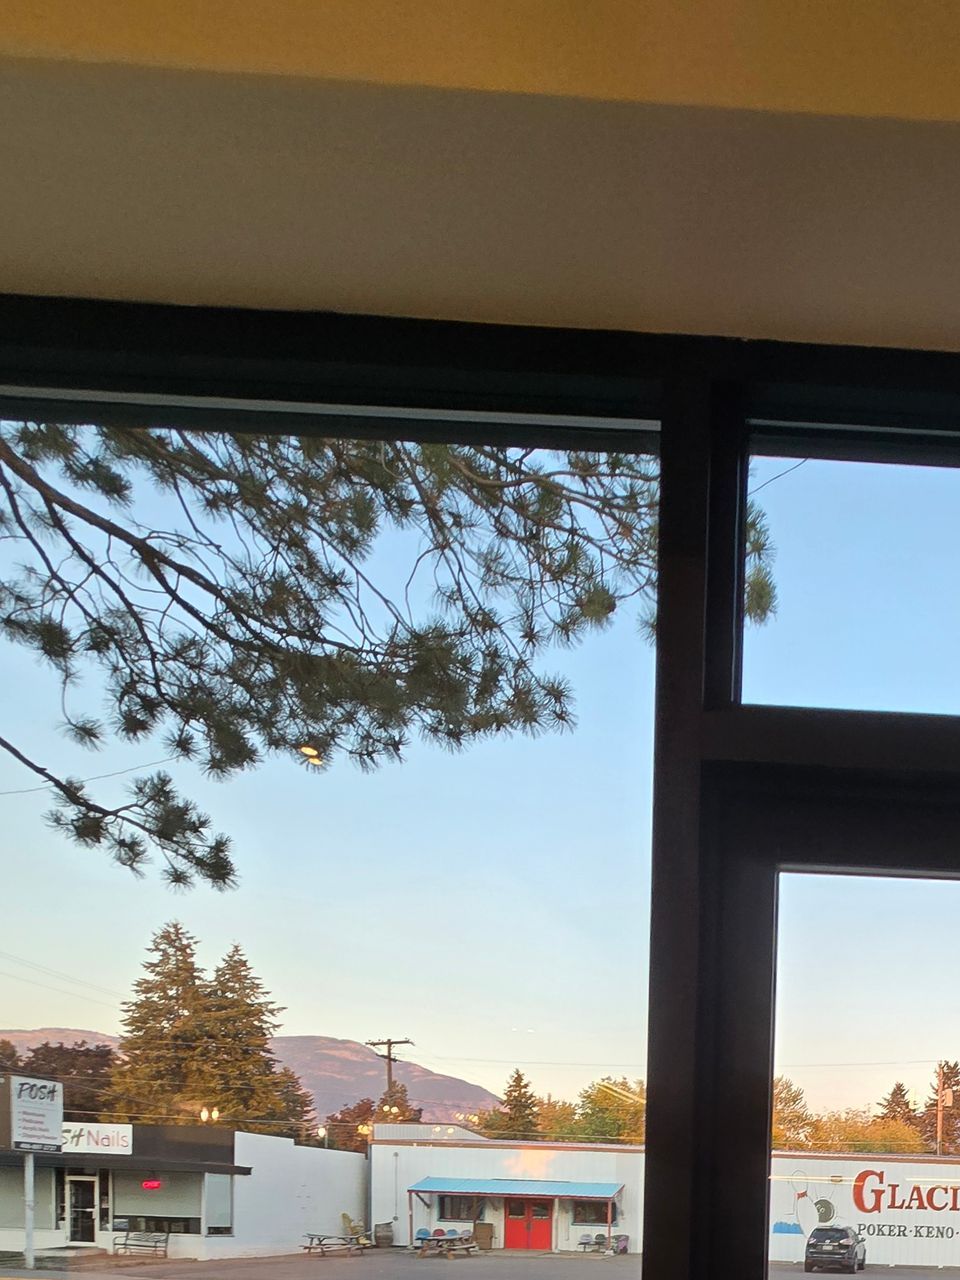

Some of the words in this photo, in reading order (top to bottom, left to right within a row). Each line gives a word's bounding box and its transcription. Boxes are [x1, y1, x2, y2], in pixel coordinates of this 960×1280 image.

[17, 1082, 57, 1101] POSH
[62, 1128, 84, 1147] SH
[86, 1130, 129, 1148] Nails
[857, 1223, 908, 1237] POKER
[913, 1225, 954, 1239] KENO
